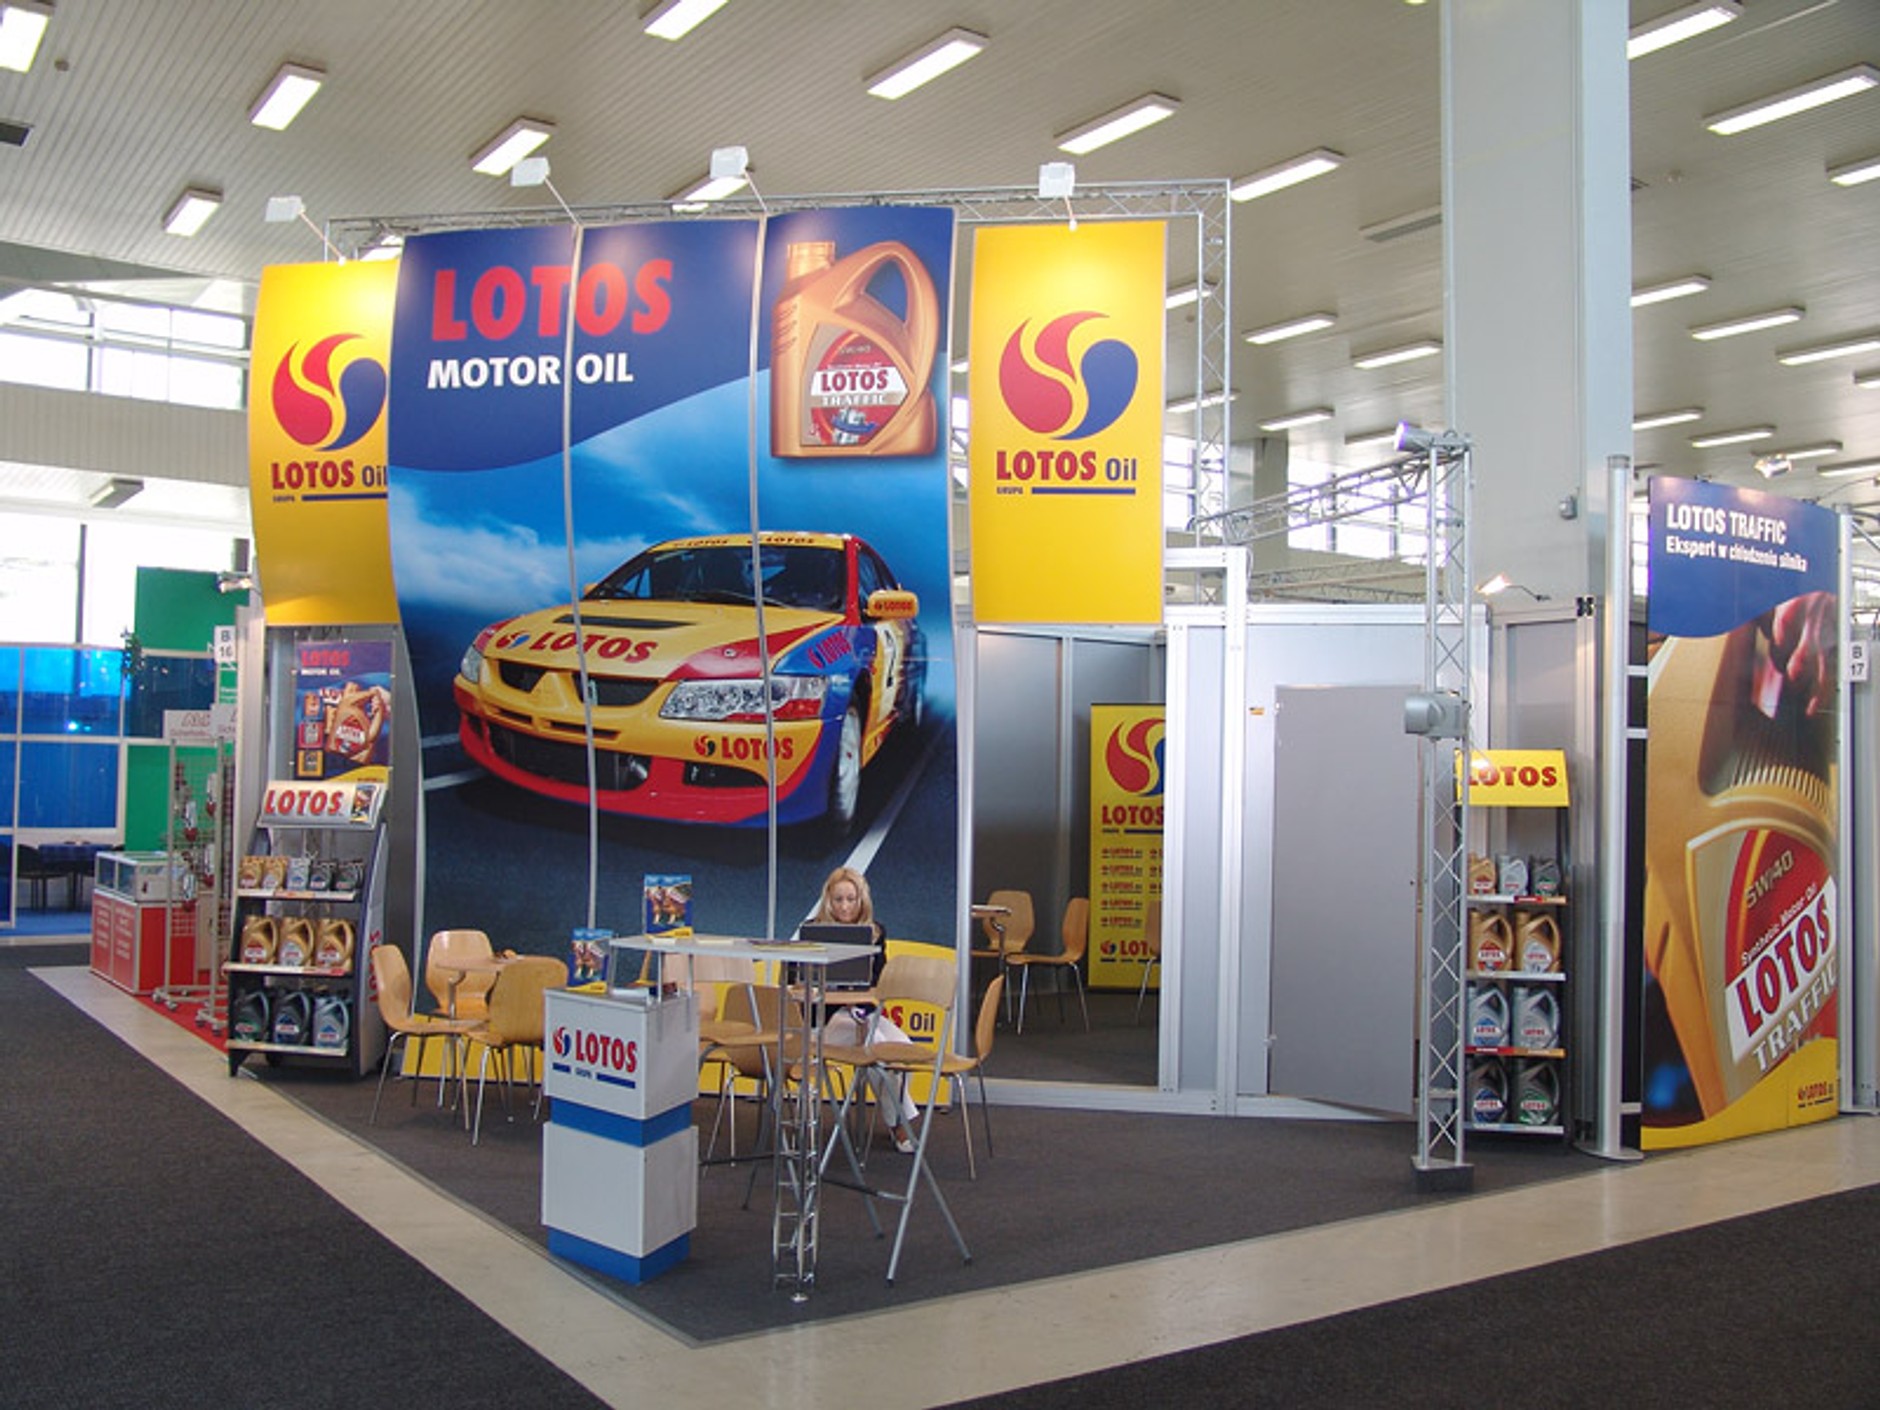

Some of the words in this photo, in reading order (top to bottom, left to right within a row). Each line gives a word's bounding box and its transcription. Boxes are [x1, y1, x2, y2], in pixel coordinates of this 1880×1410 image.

[432, 259, 674, 341] LOTOS
[428, 355, 561, 389] MOTOR
[576, 353, 633, 384] OIL
[821, 370, 889, 391] LOTOS
[271, 459, 355, 489] LOTOS
[996, 450, 1096, 480] LOTOS
[1105, 457, 1137, 481] Oil
[1666, 503, 1726, 535] LOTOS
[1729, 510, 1788, 545] TRAFFIC
[1666, 535, 1716, 559] Ekspert
[1718, 544, 1728, 558] w
[221, 630, 231, 642] B
[529, 631, 658, 664] LOTOS
[302, 650, 350, 667] LOTOS
[1851, 662, 1864, 675] 17
[721, 735, 793, 760] LOTOS
[264, 790, 344, 815] LOTOS
[1737, 893, 1831, 1038] LOTOS
[910, 1012, 935, 1032] Oil
[576, 1029, 637, 1073] LOTOS
